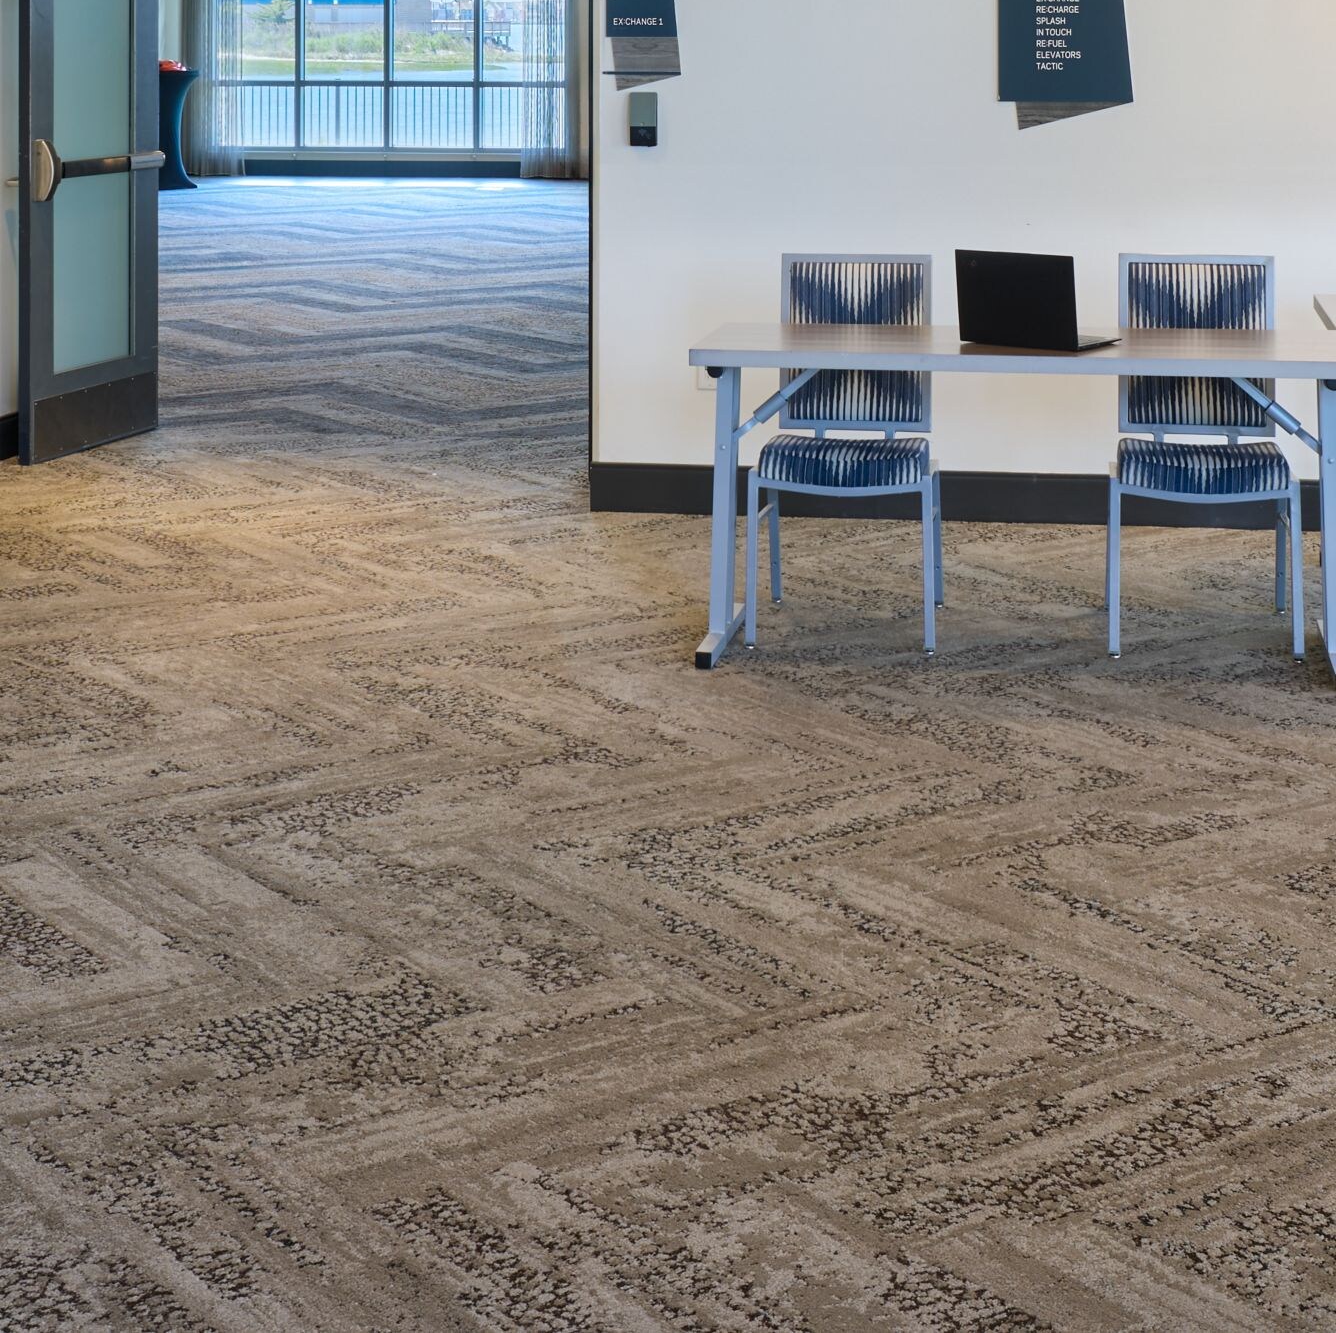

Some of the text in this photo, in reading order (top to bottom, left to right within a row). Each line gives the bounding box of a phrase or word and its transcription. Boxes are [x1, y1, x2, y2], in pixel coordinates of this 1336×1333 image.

[658, 17, 664, 26] 1
[1035, 16, 1066, 25] SPLASH
[1036, 28, 1072, 37] IN TOUCH
[1035, 51, 1082, 60] ELEVATORS
[1036, 62, 1064, 71] TACTIC
